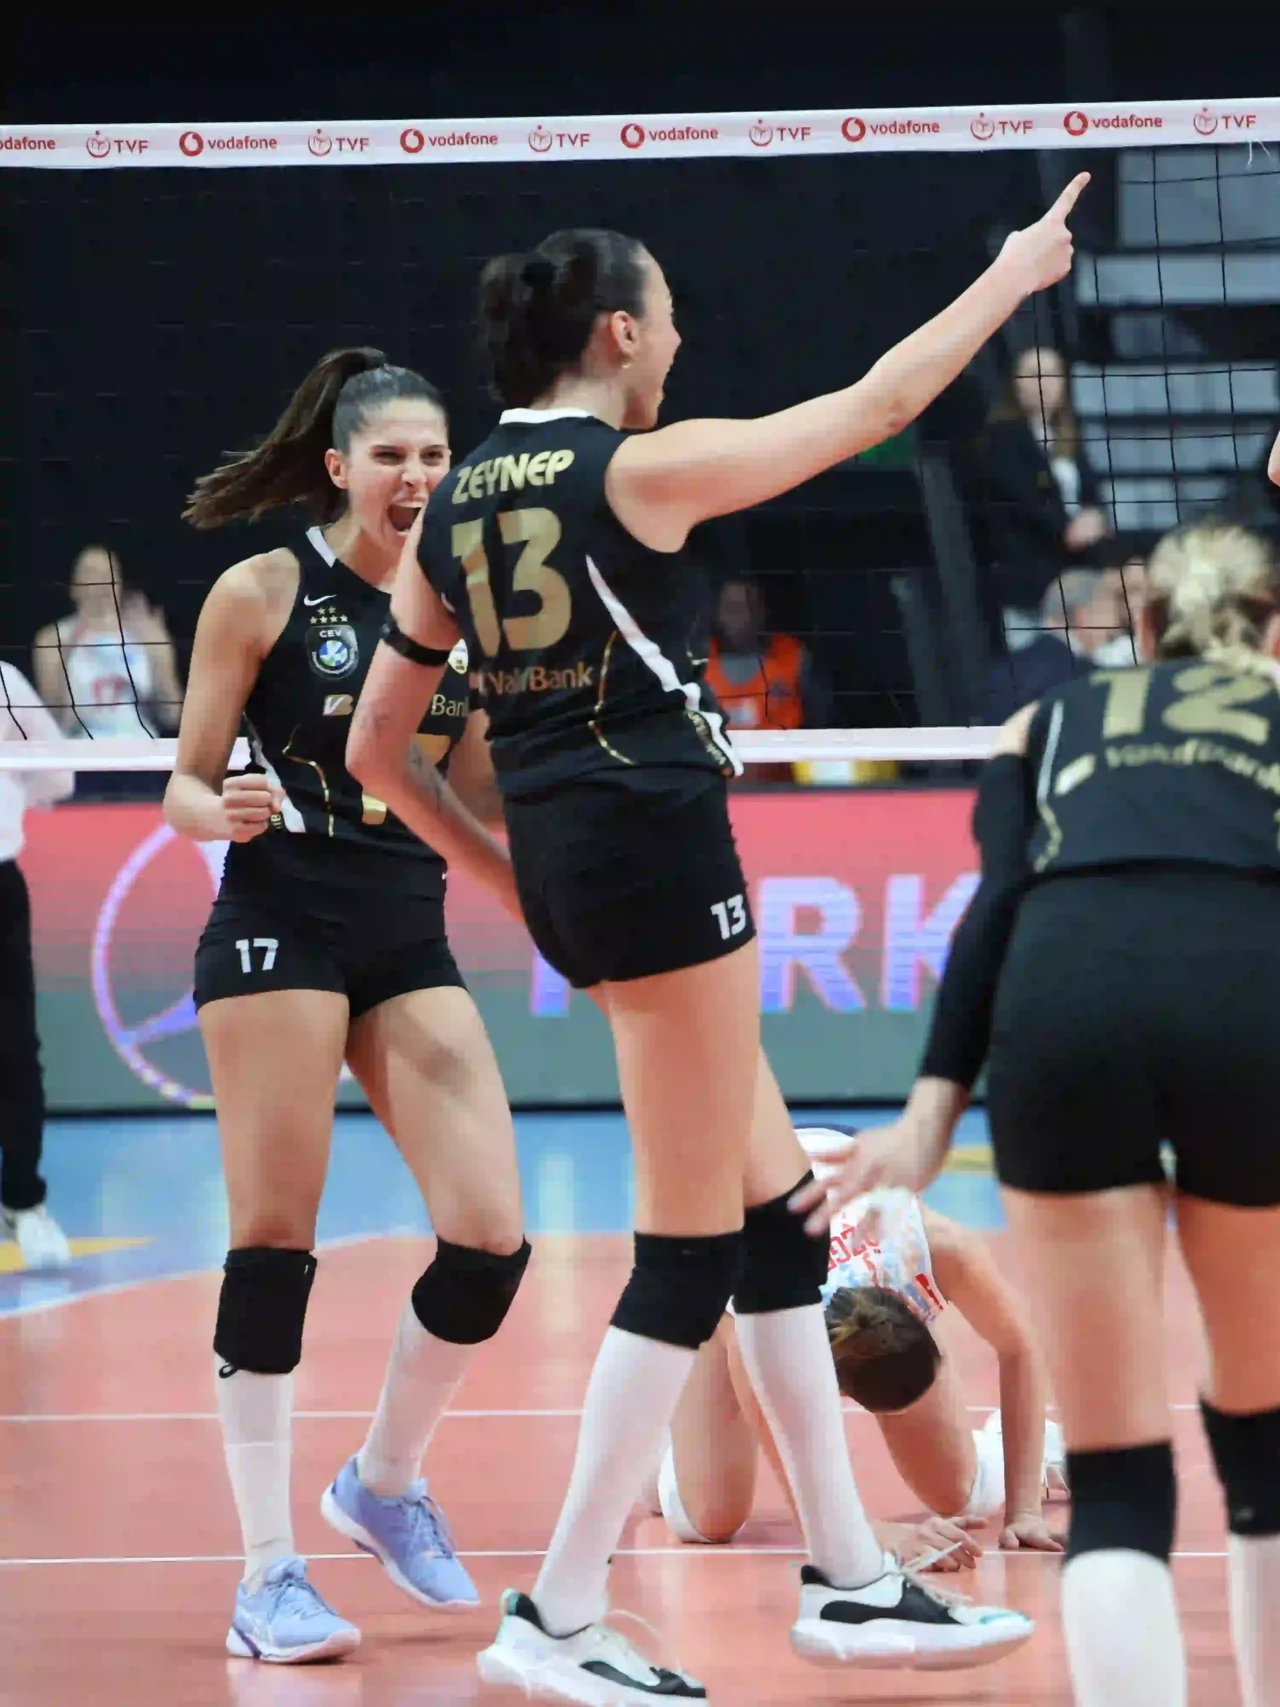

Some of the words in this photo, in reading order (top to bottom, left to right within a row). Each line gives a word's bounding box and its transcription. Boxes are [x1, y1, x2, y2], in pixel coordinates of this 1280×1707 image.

[0, 136, 57, 150] dafone
[113, 139, 148, 152] TVF
[209, 136, 278, 149] vodafone
[336, 136, 369, 148] TVF
[428, 133, 499, 146] vodafone
[557, 132, 590, 145] TVF
[648, 126, 719, 140] vodafone
[778, 126, 810, 138] TVF
[869, 120, 940, 134] vodafone
[1000, 120, 1033, 132] TVF
[1092, 115, 1165, 128] vodafone
[1224, 113, 1255, 126] TVF
[451, 449, 574, 504] ZEYNEP
[451, 507, 572, 657] 13
[319, 629, 342, 638] CEV
[1089, 663, 1270, 746] 12
[710, 893, 746, 940] 13
[236, 938, 279, 973] 17
